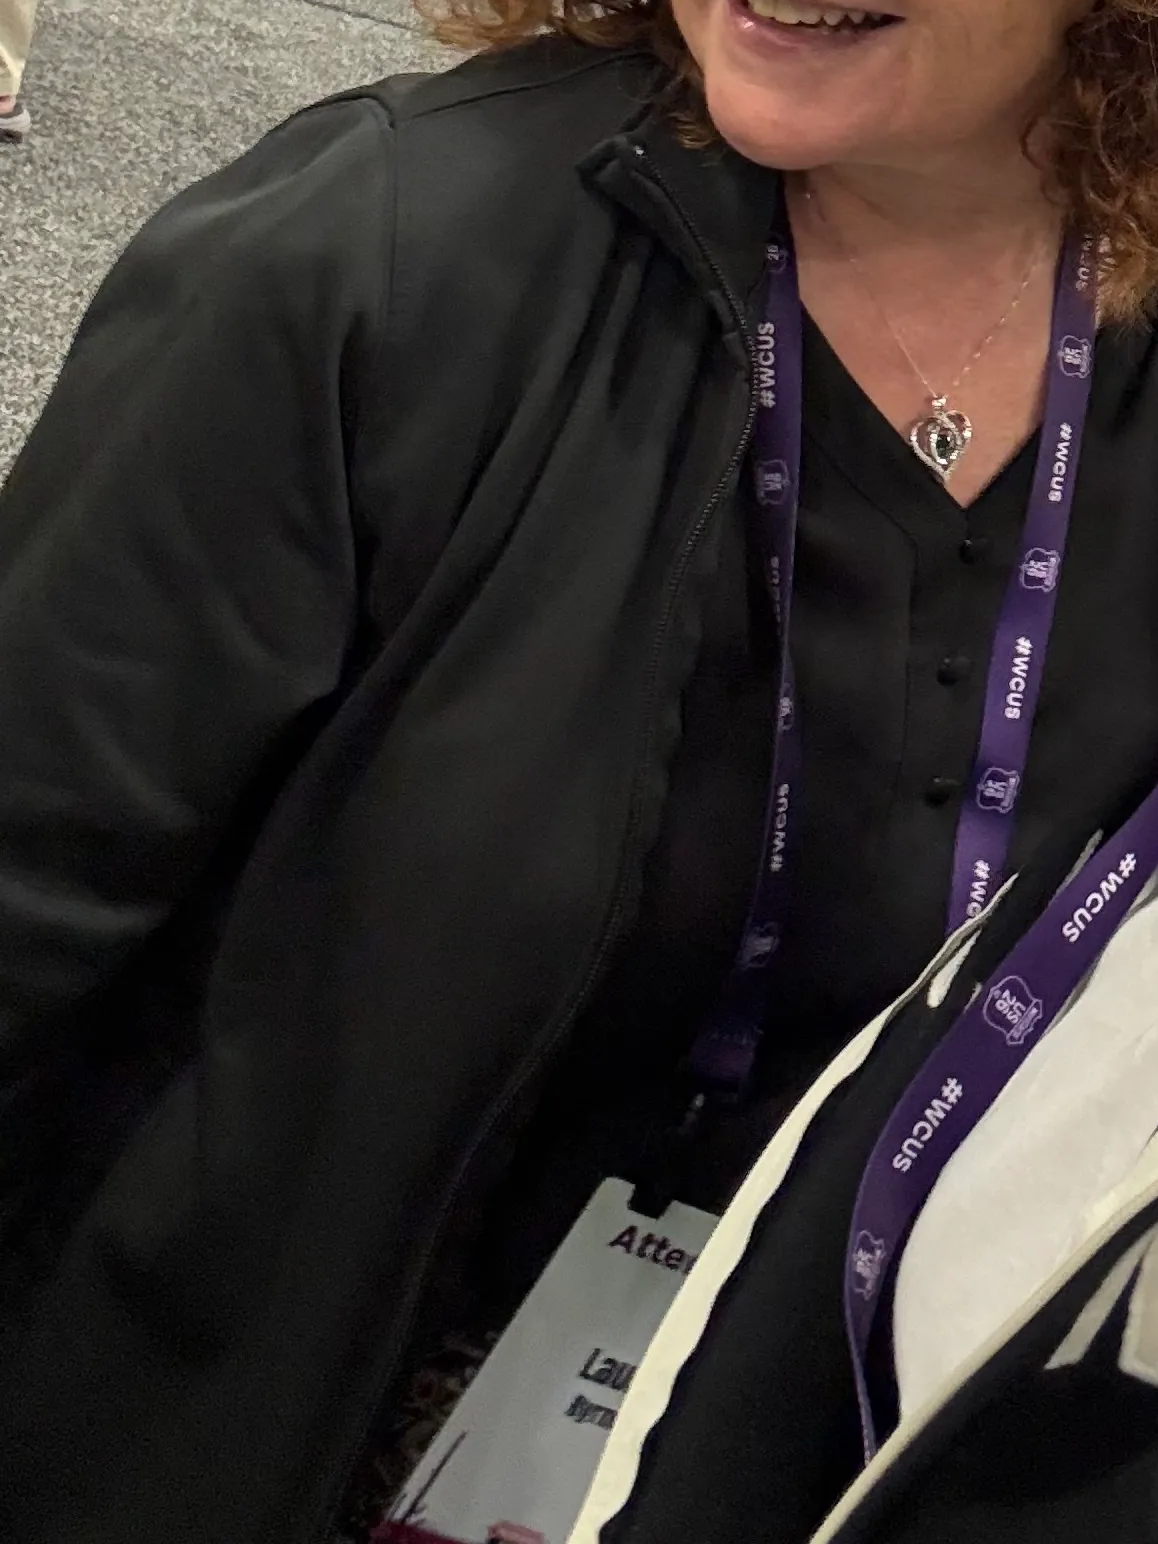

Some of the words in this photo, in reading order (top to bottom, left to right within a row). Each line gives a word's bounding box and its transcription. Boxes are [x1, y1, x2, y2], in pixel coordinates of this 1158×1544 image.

[757, 321, 776, 408] #WCUS
[1048, 422, 1073, 503] #WCUS
[1004, 636, 1033, 720] #WCUS
[966, 859, 991, 918] #WC
[1062, 853, 1137, 943] #WCUS
[892, 1077, 964, 1173] #WCUS
